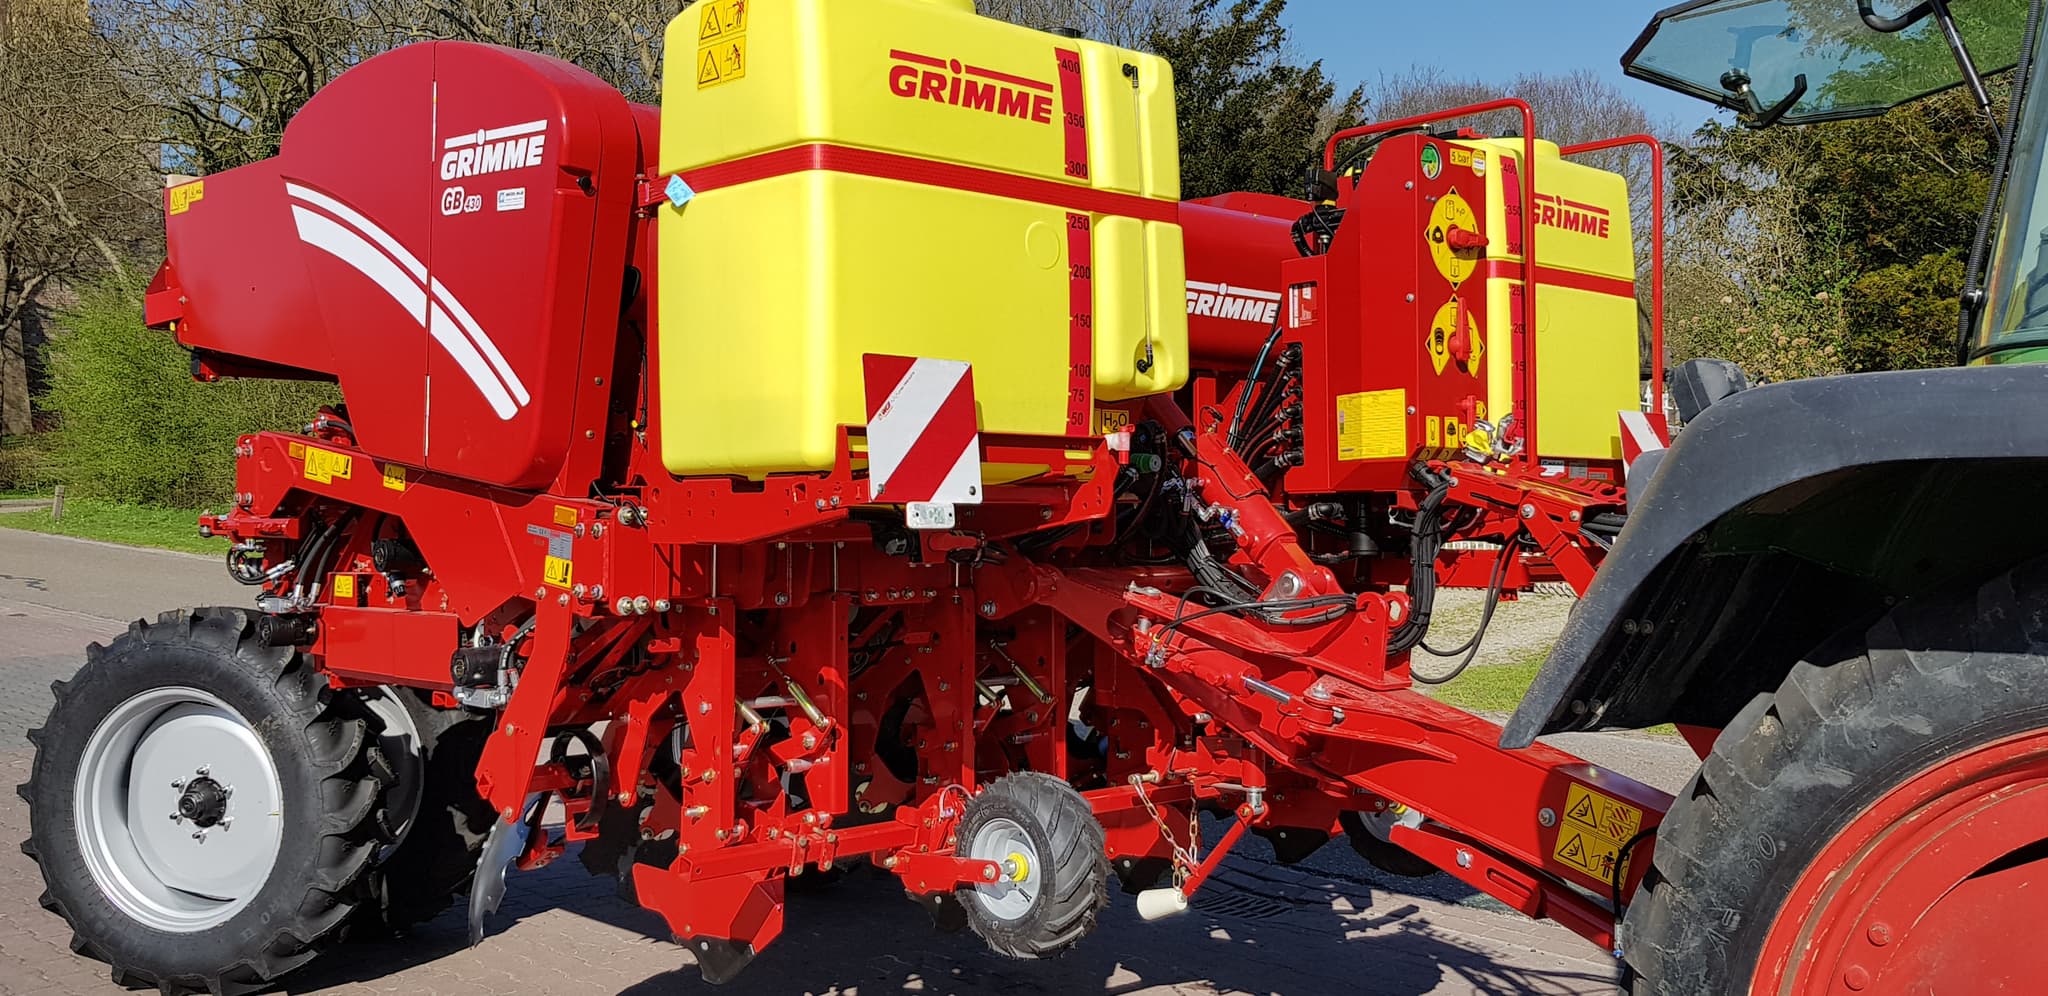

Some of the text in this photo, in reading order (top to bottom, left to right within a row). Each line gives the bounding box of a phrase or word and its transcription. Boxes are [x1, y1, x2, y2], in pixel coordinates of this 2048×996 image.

[1061, 58, 1080, 74] 400
[889, 58, 1053, 124] GRIMME
[1067, 112, 1085, 128] 350
[441, 129, 545, 180] GRIMME
[1451, 151, 1456, 162] 5
[1458, 151, 1469, 164] bar
[1069, 161, 1087, 177] 300
[442, 187, 463, 214] GB
[465, 196, 481, 211] 430
[1071, 215, 1089, 231] 250
[1073, 264, 1091, 280] 200
[1512, 286, 1522, 297] 25
[1073, 313, 1091, 328] 150
[1514, 323, 1525, 334] 20
[1073, 363, 1091, 377] 100
[1515, 360, 1525, 371] 15
[1072, 388, 1085, 402] 75
[1515, 400, 1525, 410] 10
[1071, 412, 1084, 425] 50
[1103, 413, 1128, 431] H2O
